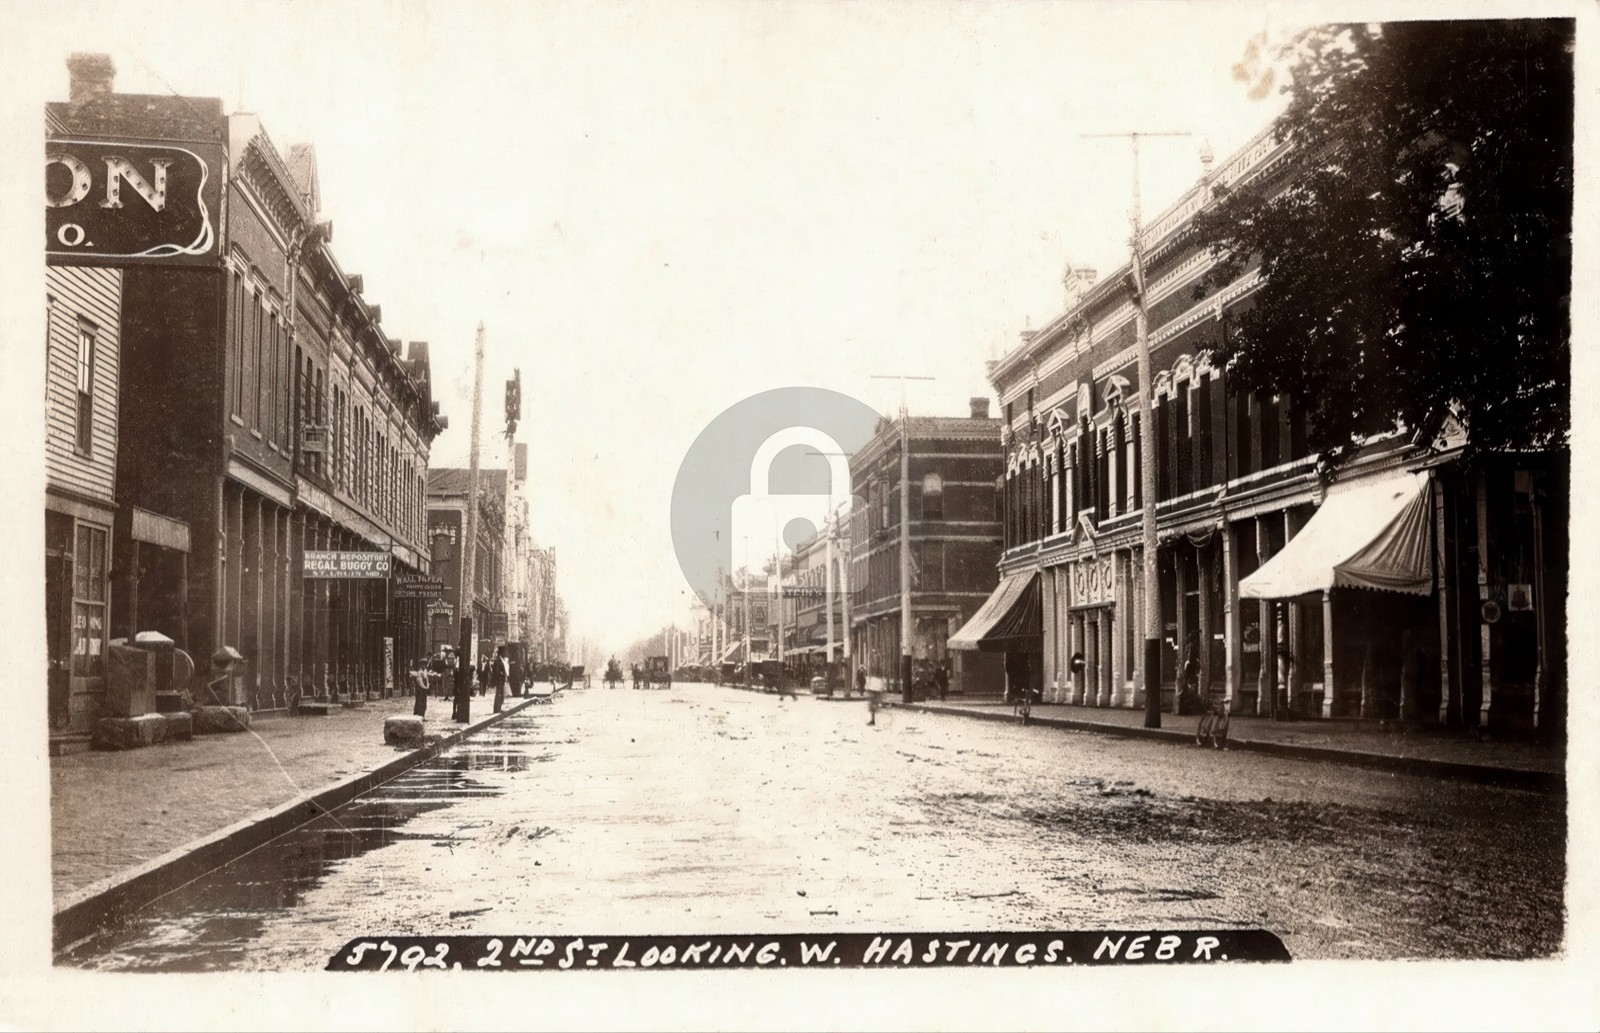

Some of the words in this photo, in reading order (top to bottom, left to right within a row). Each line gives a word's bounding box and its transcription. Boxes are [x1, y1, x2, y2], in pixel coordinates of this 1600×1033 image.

[304, 553, 337, 561] BRANCH
[304, 560, 338, 570] REGAL
[340, 561, 372, 570] BUGGY
[376, 561, 389, 571] CO
